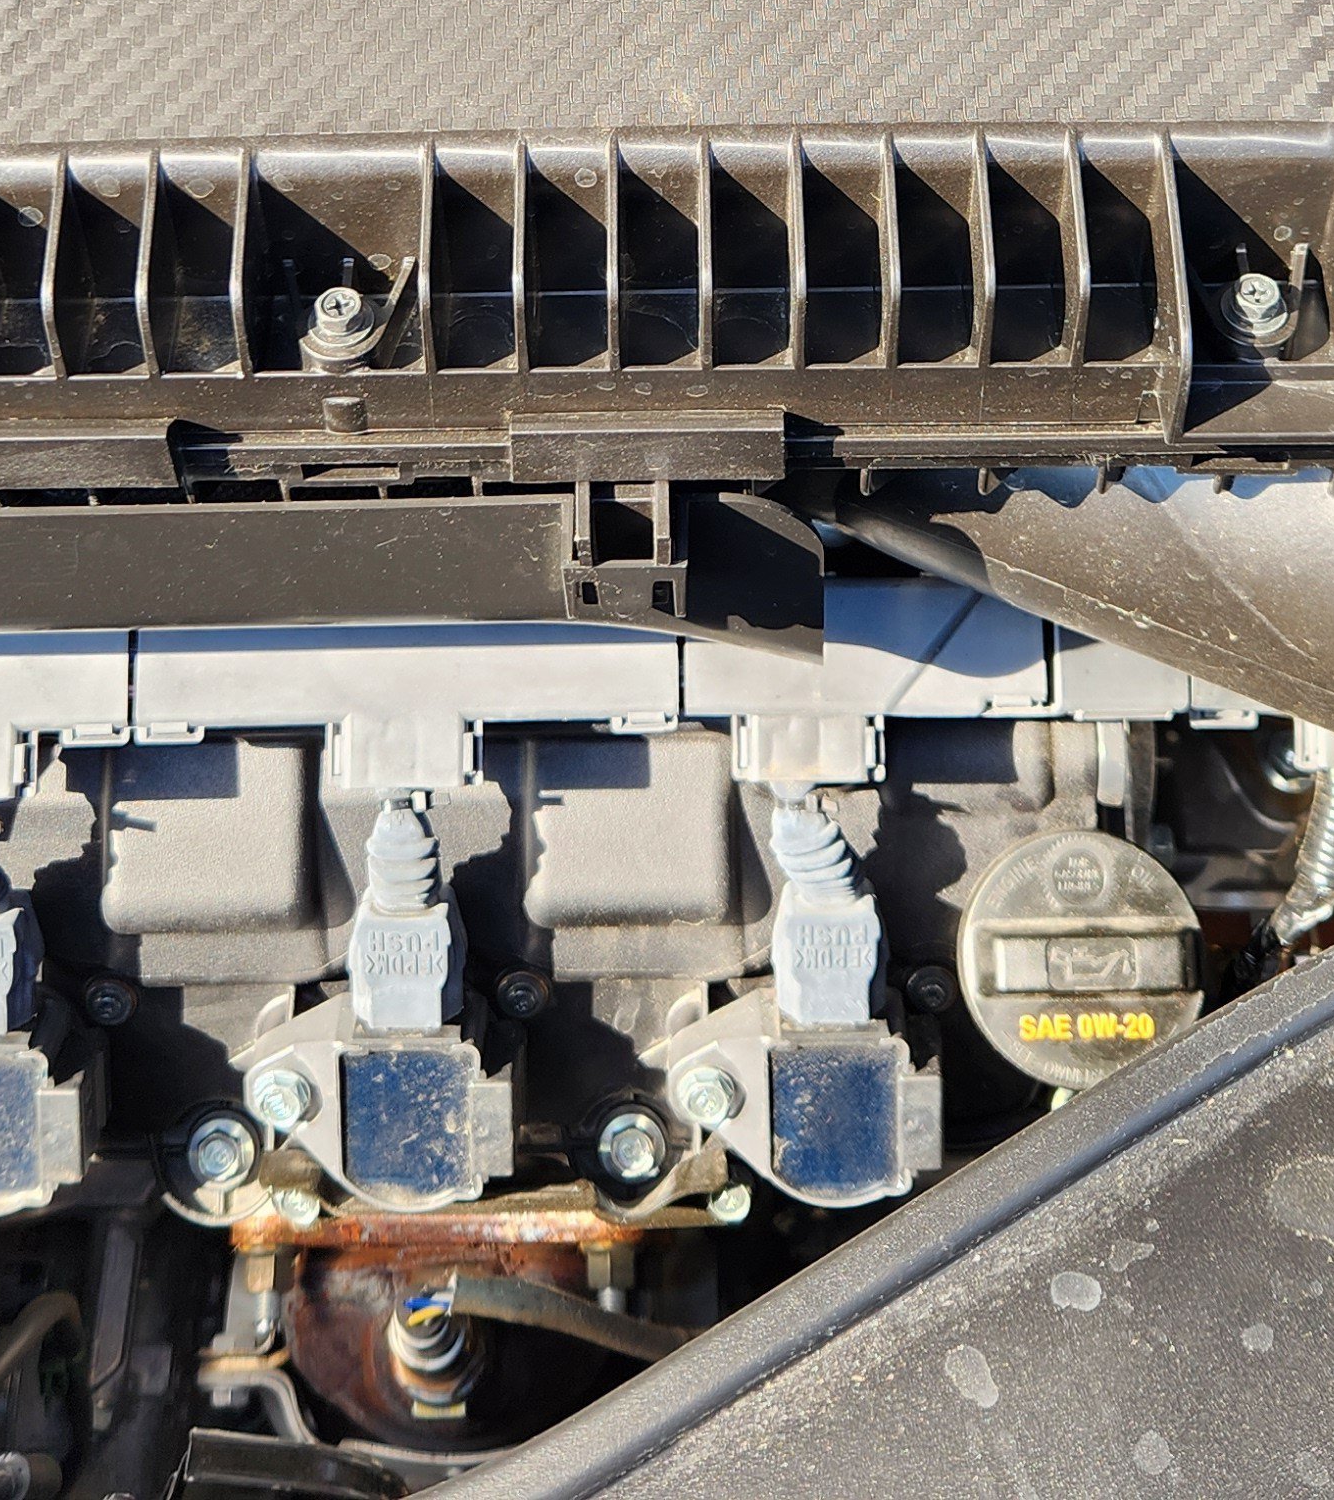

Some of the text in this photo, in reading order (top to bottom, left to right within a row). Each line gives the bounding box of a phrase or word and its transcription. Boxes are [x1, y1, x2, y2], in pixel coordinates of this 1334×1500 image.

[367, 930, 440, 952] PUSH
[795, 924, 868, 946] PUSH
[1019, 1012, 1156, 1041] SAE 0W-20
